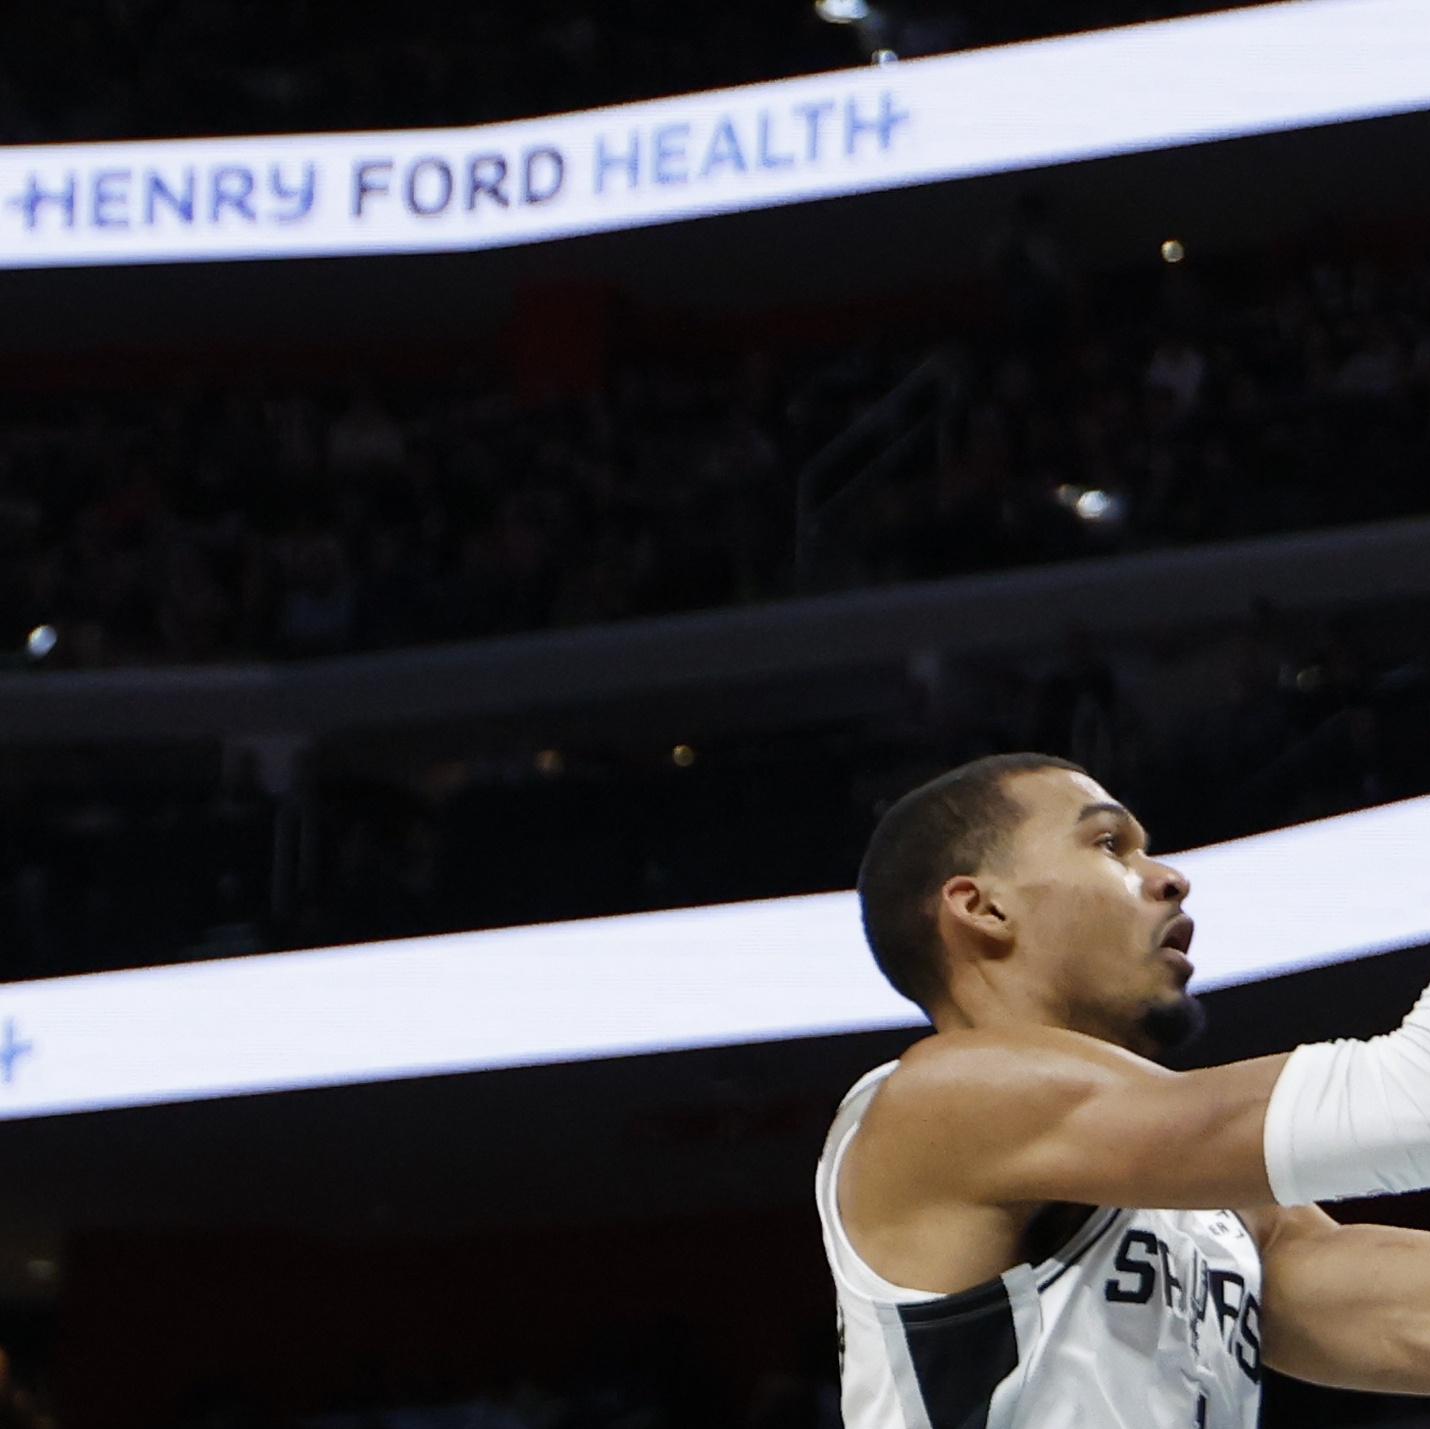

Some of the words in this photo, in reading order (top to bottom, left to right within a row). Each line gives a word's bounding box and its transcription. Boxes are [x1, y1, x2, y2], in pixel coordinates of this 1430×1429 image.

[8, 160, 317, 231] HENRY
[350, 146, 566, 221] FORD
[596, 90, 911, 195] HEALTH
